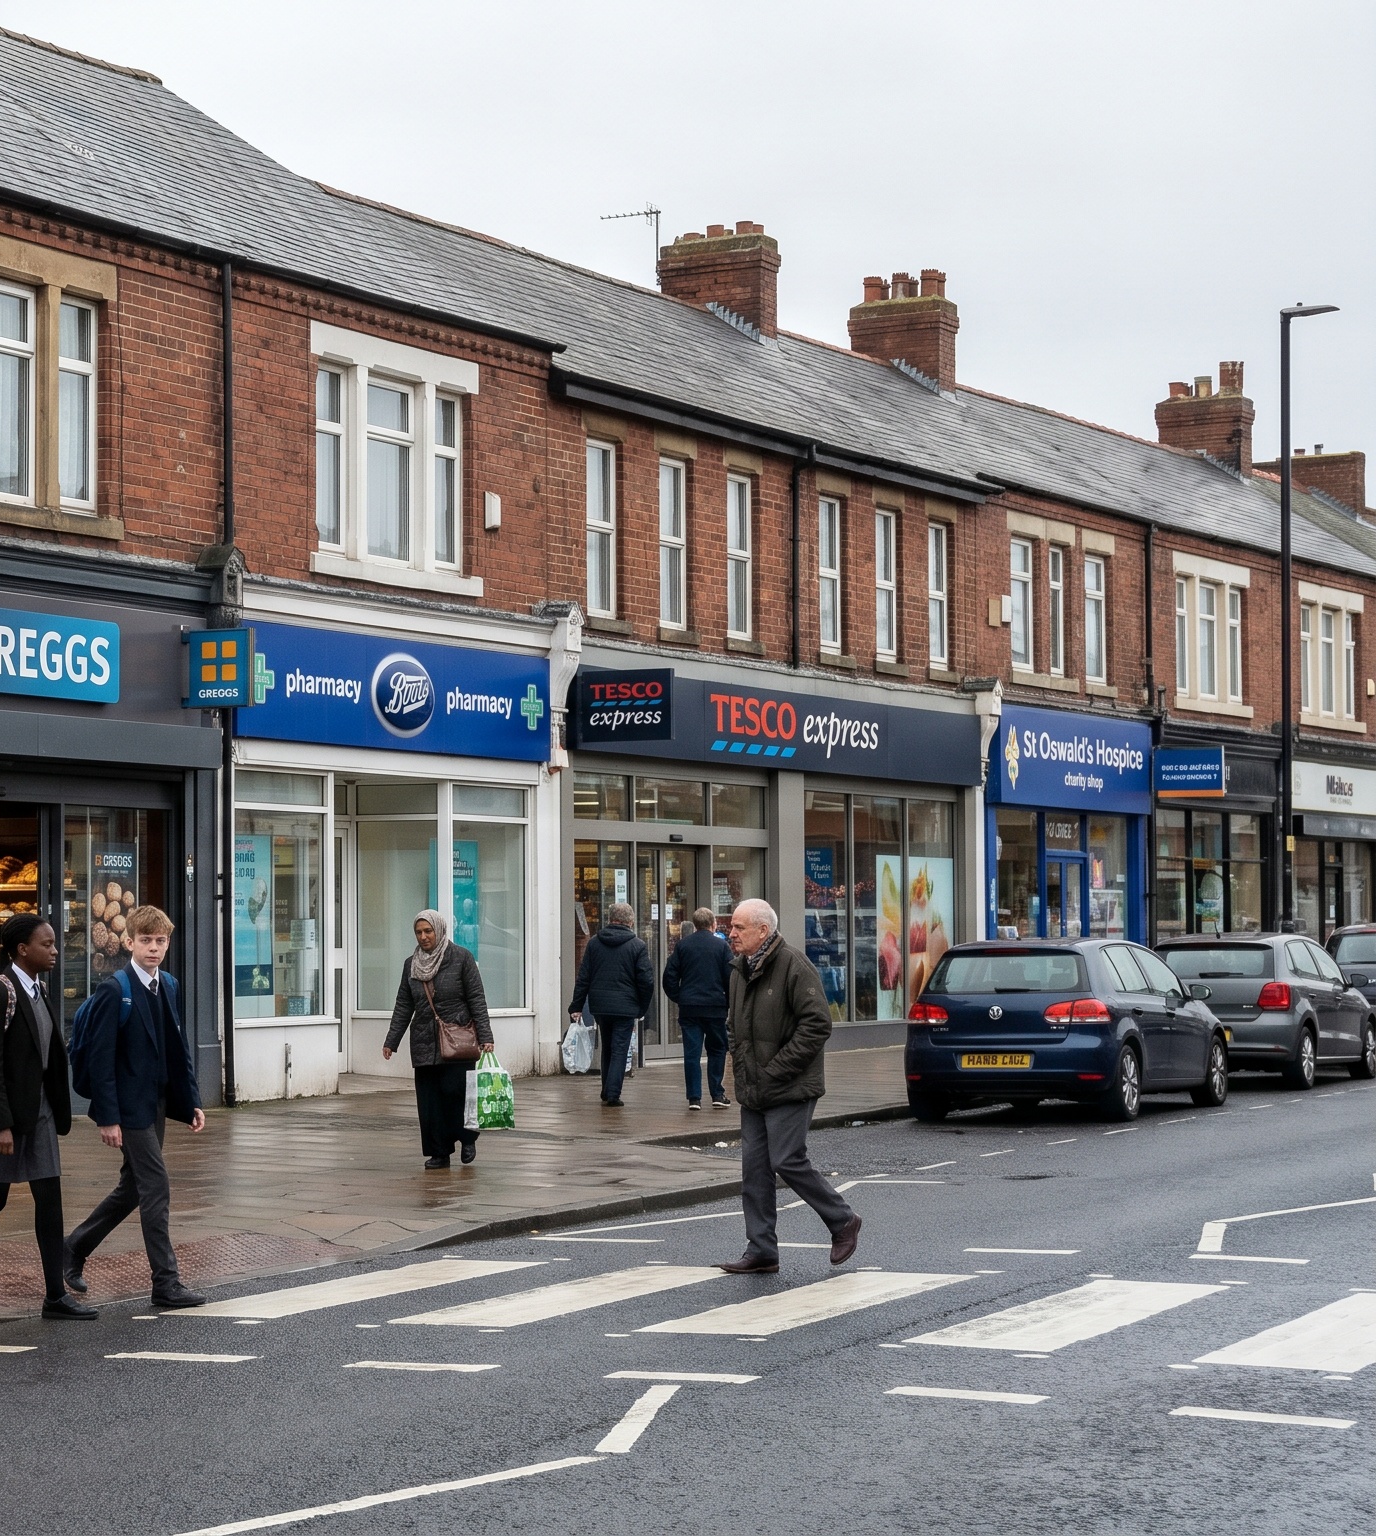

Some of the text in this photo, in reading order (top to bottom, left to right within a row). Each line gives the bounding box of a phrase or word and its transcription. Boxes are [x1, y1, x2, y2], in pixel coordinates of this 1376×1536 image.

[198, 687, 239, 699] GREGGS
[285, 667, 362, 704] pharmacy
[589, 681, 663, 700] TESCO
[446, 686, 513, 720] pharmacy
[589, 709, 662, 731] express
[709, 693, 879, 759] TESCO express
[1023, 730, 1144, 775] St Oswald's Hospice
[1064, 771, 1104, 793] charity shop
